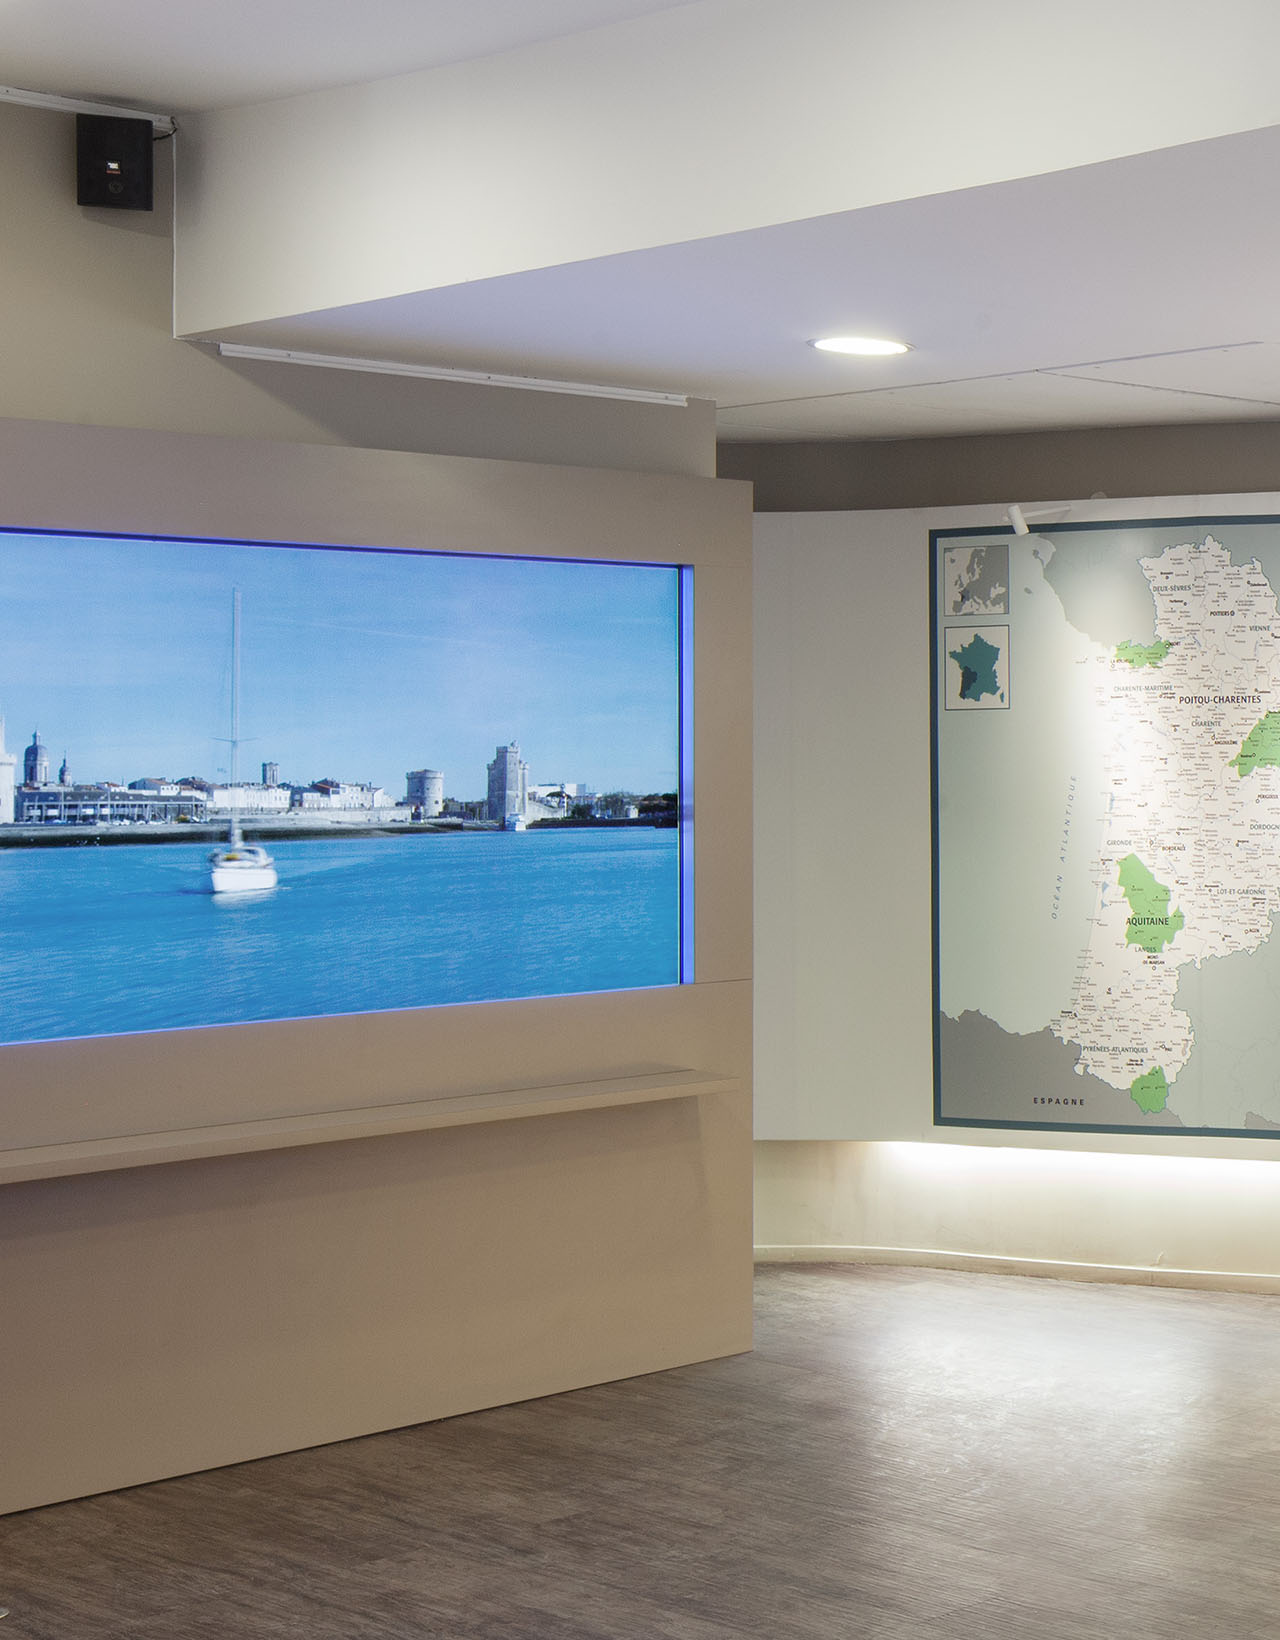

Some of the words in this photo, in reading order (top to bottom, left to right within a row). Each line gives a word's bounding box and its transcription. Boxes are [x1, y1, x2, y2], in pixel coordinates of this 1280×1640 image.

[1153, 584, 1192, 592] DEUX-SÈVRES
[1179, 695, 1261, 704] POITOU-CHARENTES
[1216, 887, 1266, 895] LOT-ET-GARONNE
[1126, 917, 1169, 926] AQUITAINE
[1083, 1045, 1148, 1054] PYRÉNÉES-ATLANTIQUES
[1033, 1096, 1085, 1106] ESPAGNE
